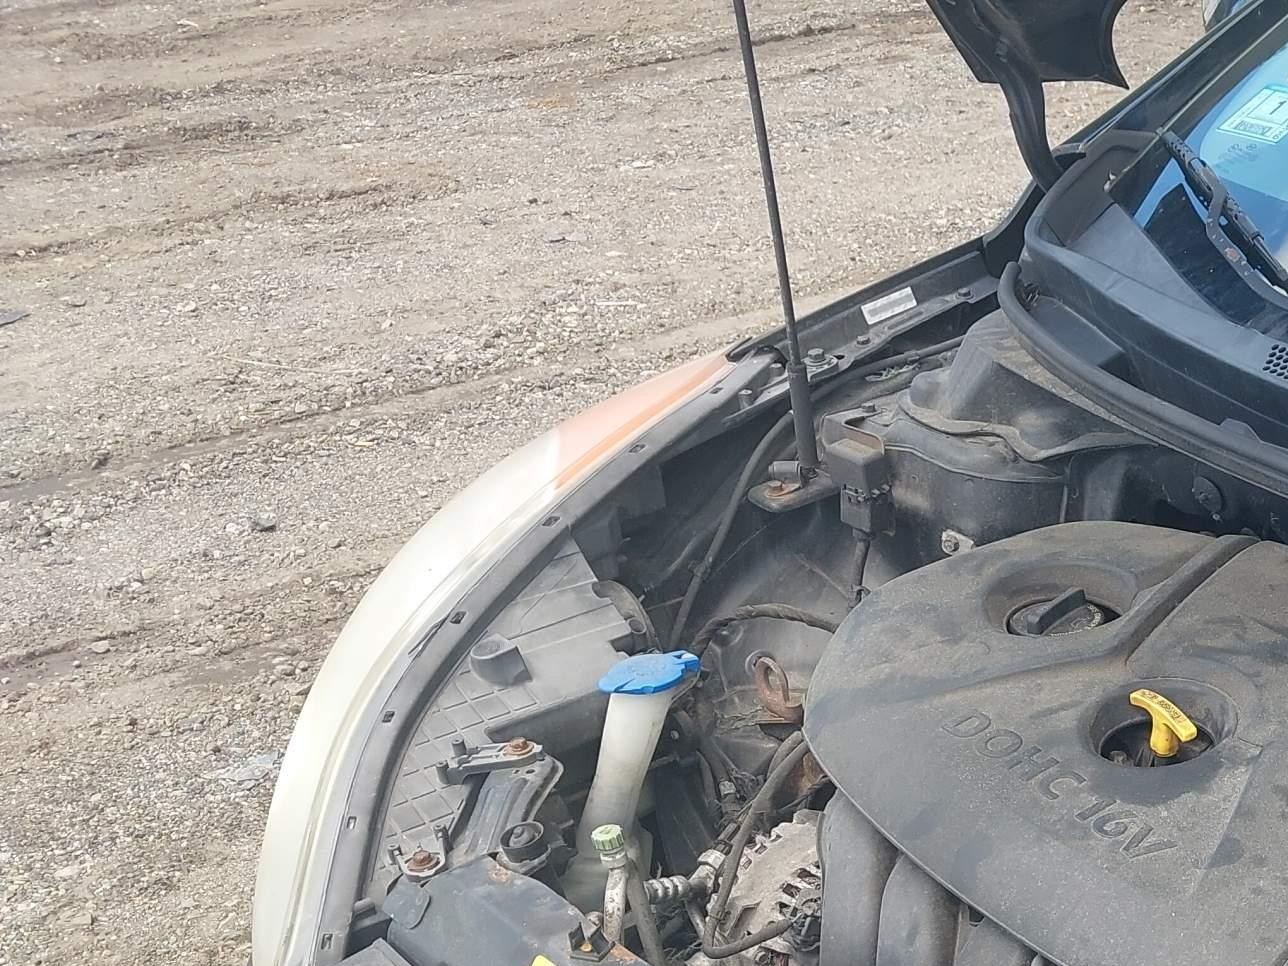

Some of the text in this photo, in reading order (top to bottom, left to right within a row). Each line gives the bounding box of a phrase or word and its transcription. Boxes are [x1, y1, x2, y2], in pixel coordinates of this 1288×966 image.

[1267, 100, 1287, 115] 1
[941, 710, 1178, 859] DOHC 16V
